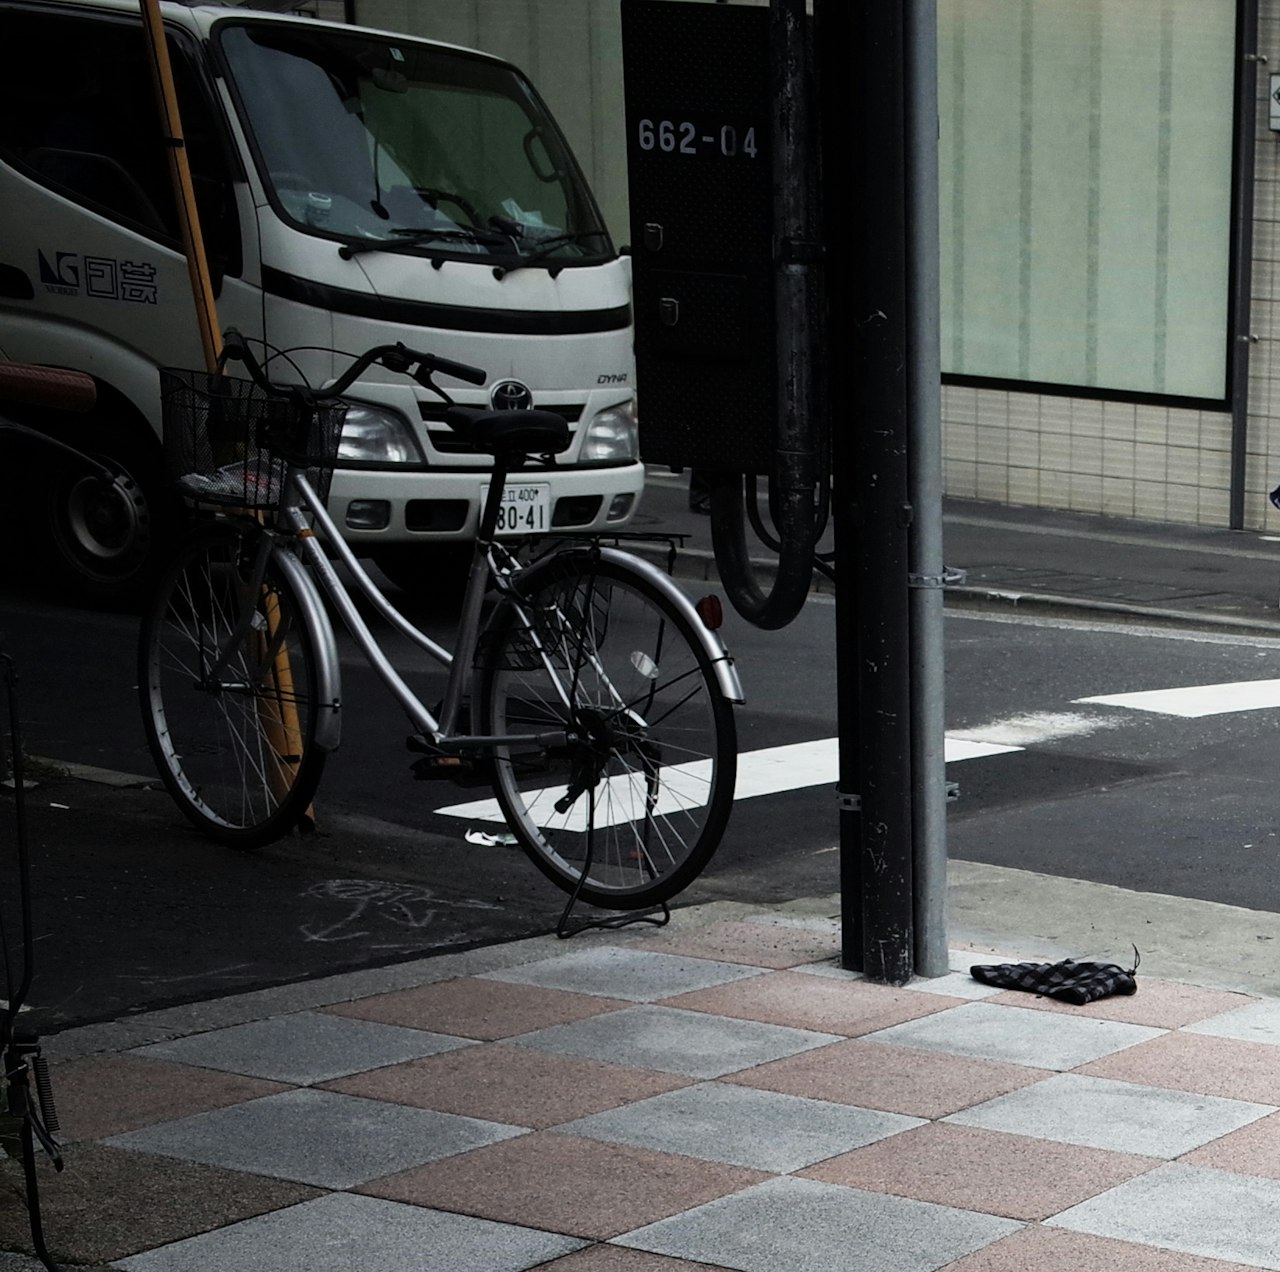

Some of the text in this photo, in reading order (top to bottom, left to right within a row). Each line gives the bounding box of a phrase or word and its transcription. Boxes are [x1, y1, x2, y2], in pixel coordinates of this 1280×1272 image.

[638, 118, 758, 159] 662-04
[597, 373, 628, 385] DYNA
[518, 488, 535, 502] 400
